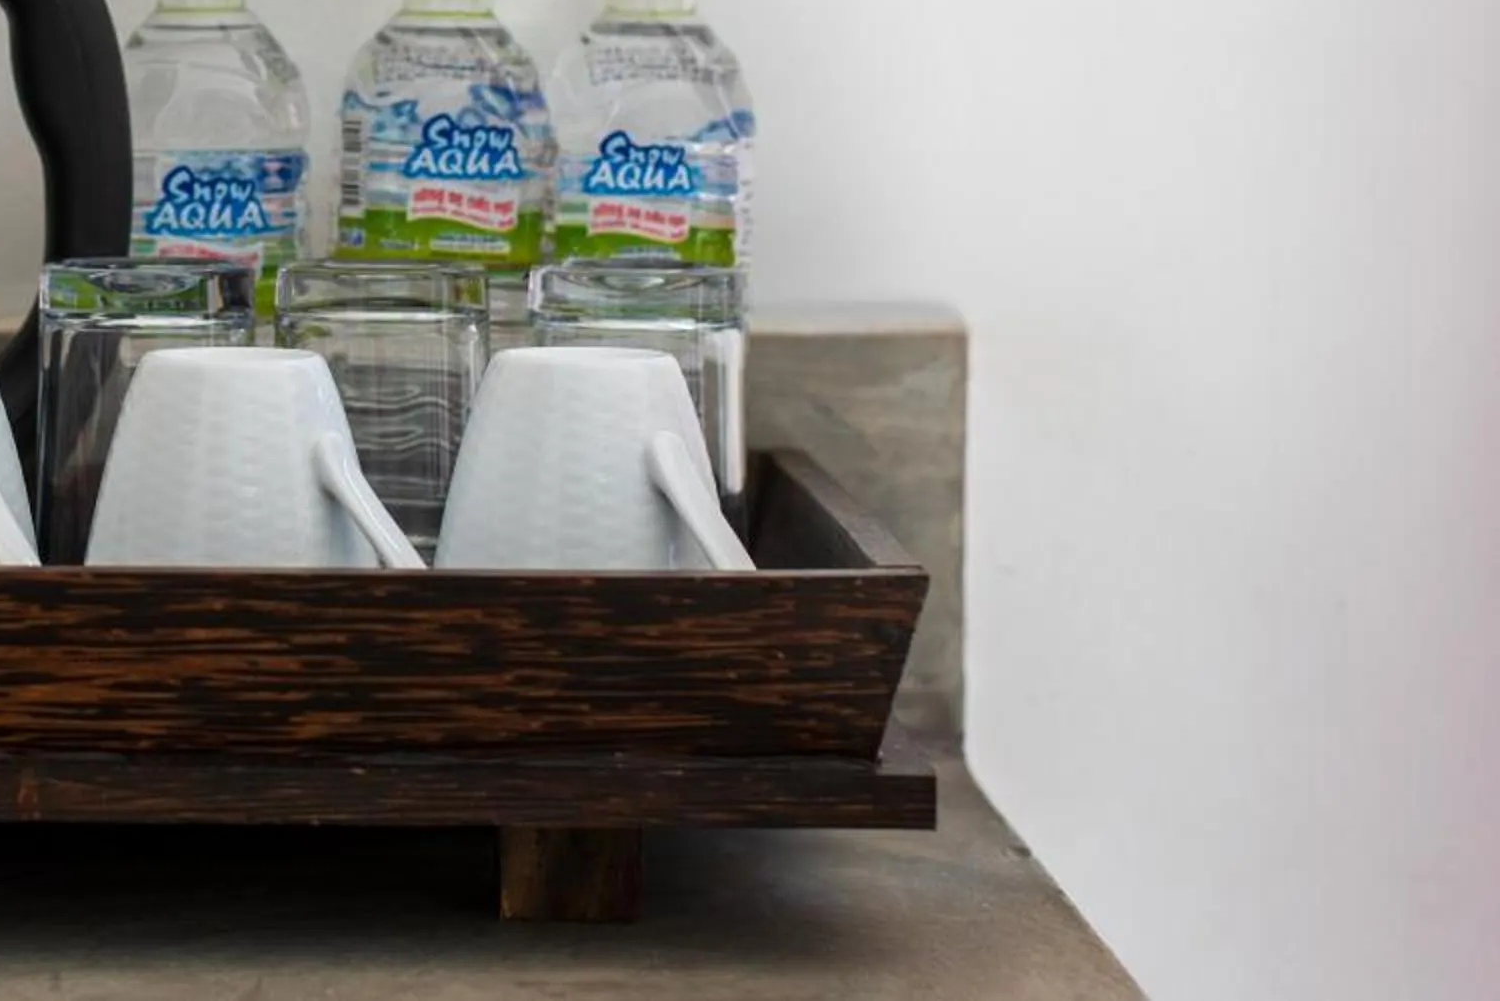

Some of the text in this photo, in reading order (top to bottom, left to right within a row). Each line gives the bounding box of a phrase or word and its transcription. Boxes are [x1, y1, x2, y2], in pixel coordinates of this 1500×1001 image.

[428, 117, 510, 150] Snow
[410, 147, 520, 176] AQUA
[605, 134, 681, 165] Snow
[167, 169, 252, 204] Snow
[588, 160, 691, 190] AQUA
[152, 201, 265, 231] AQUA
